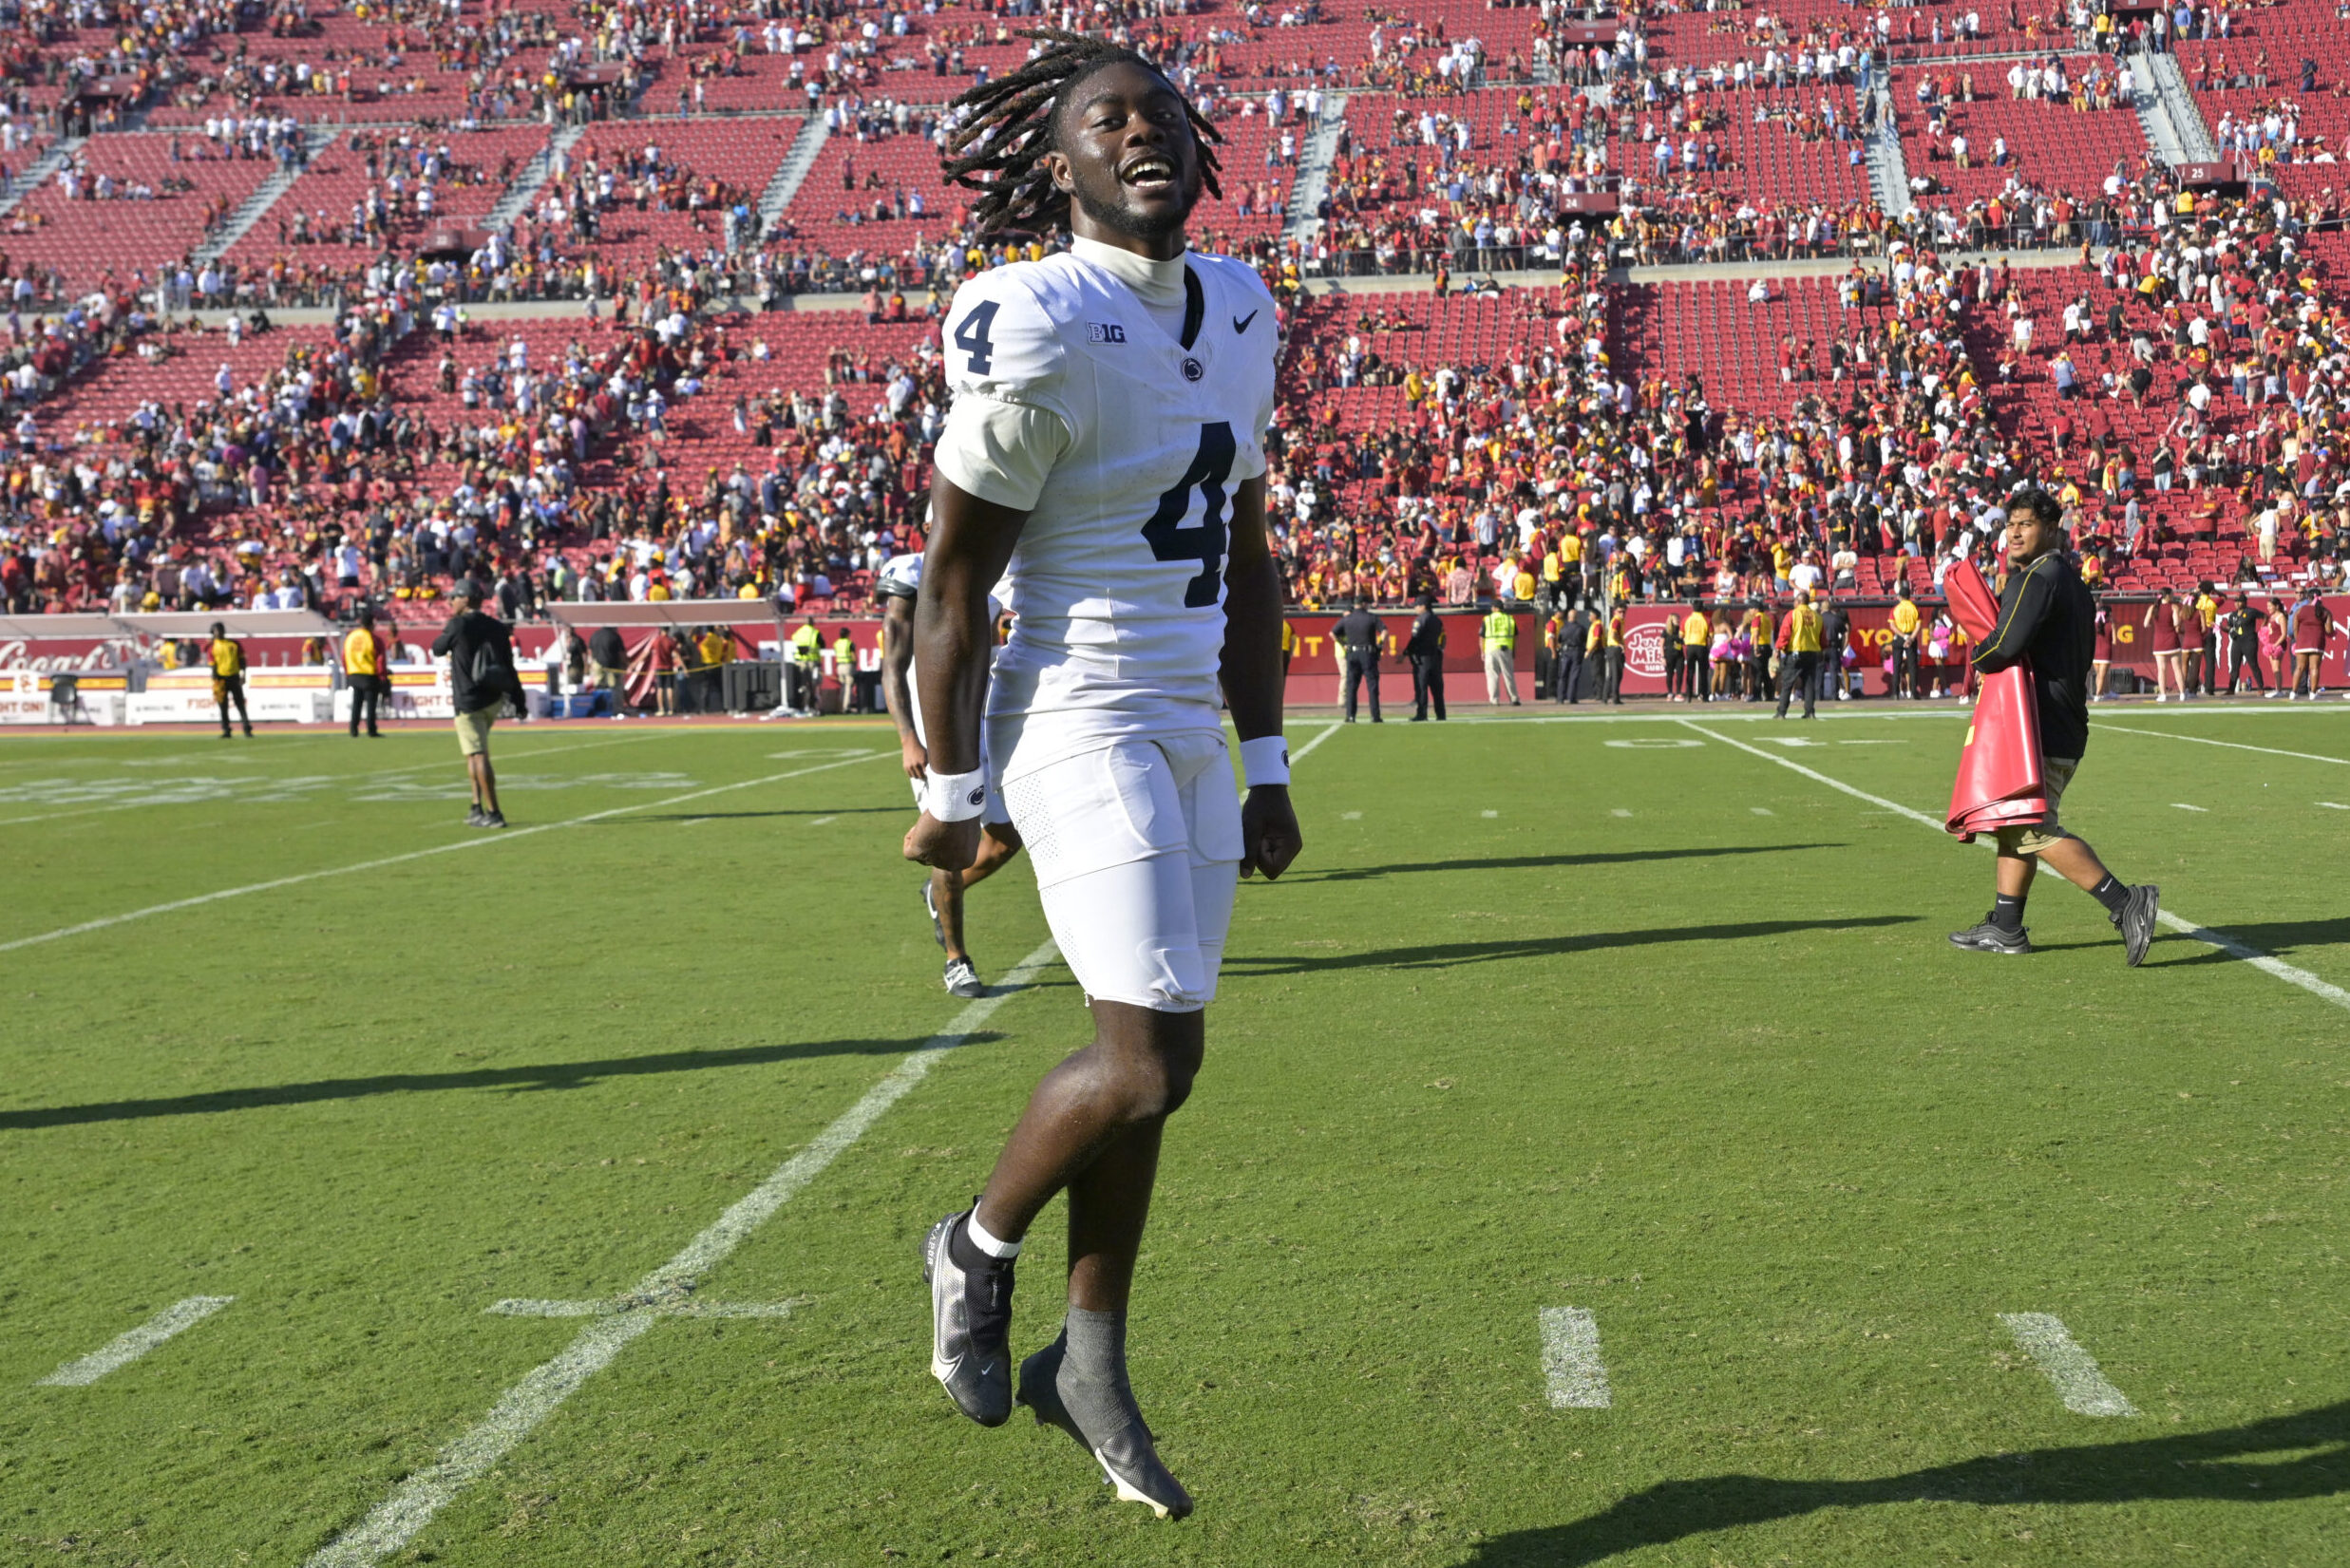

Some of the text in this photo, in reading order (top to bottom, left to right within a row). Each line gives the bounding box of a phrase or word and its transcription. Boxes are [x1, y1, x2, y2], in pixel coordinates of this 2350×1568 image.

[2191, 168, 2204, 179] 25
[1565, 198, 1578, 208] 24
[954, 299, 1000, 376] 4
[1141, 421, 1236, 609] 4
[403, 695, 442, 707] FIGHT
